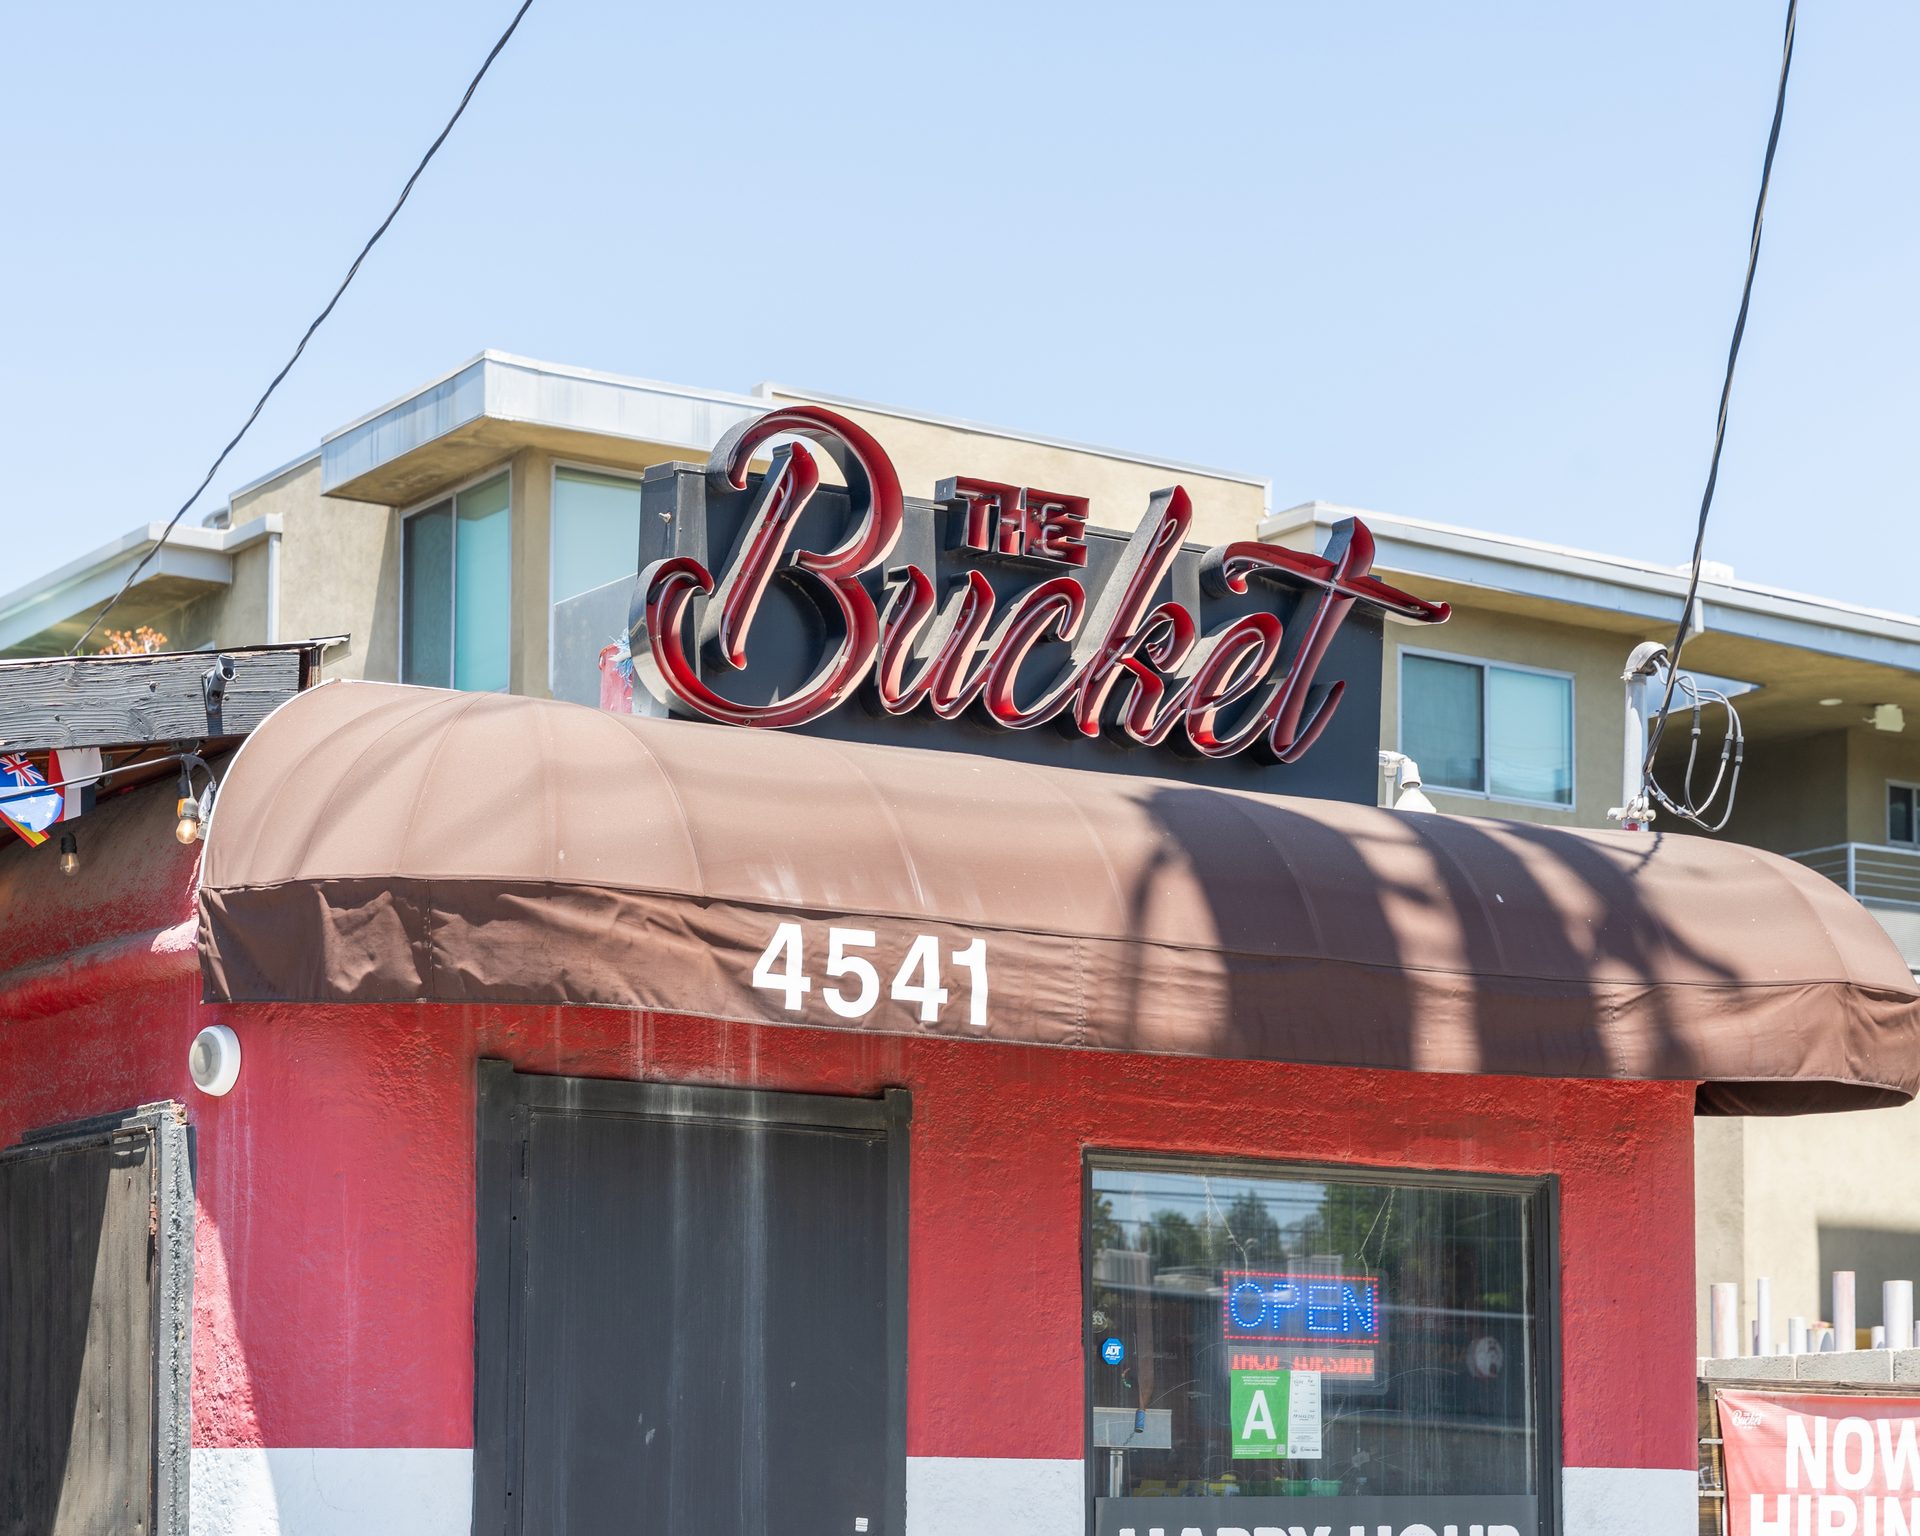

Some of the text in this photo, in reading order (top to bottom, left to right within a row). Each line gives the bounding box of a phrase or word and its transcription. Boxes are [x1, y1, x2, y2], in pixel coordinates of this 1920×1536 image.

[938, 475, 1090, 567] THE
[638, 405, 1451, 764] Bucket
[752, 922, 989, 1026] 4541
[1230, 1281, 1372, 1332] OPEN
[1105, 1345, 1121, 1356] ADT
[1241, 1389, 1277, 1440] A
[1786, 1414, 1920, 1492] NOW
